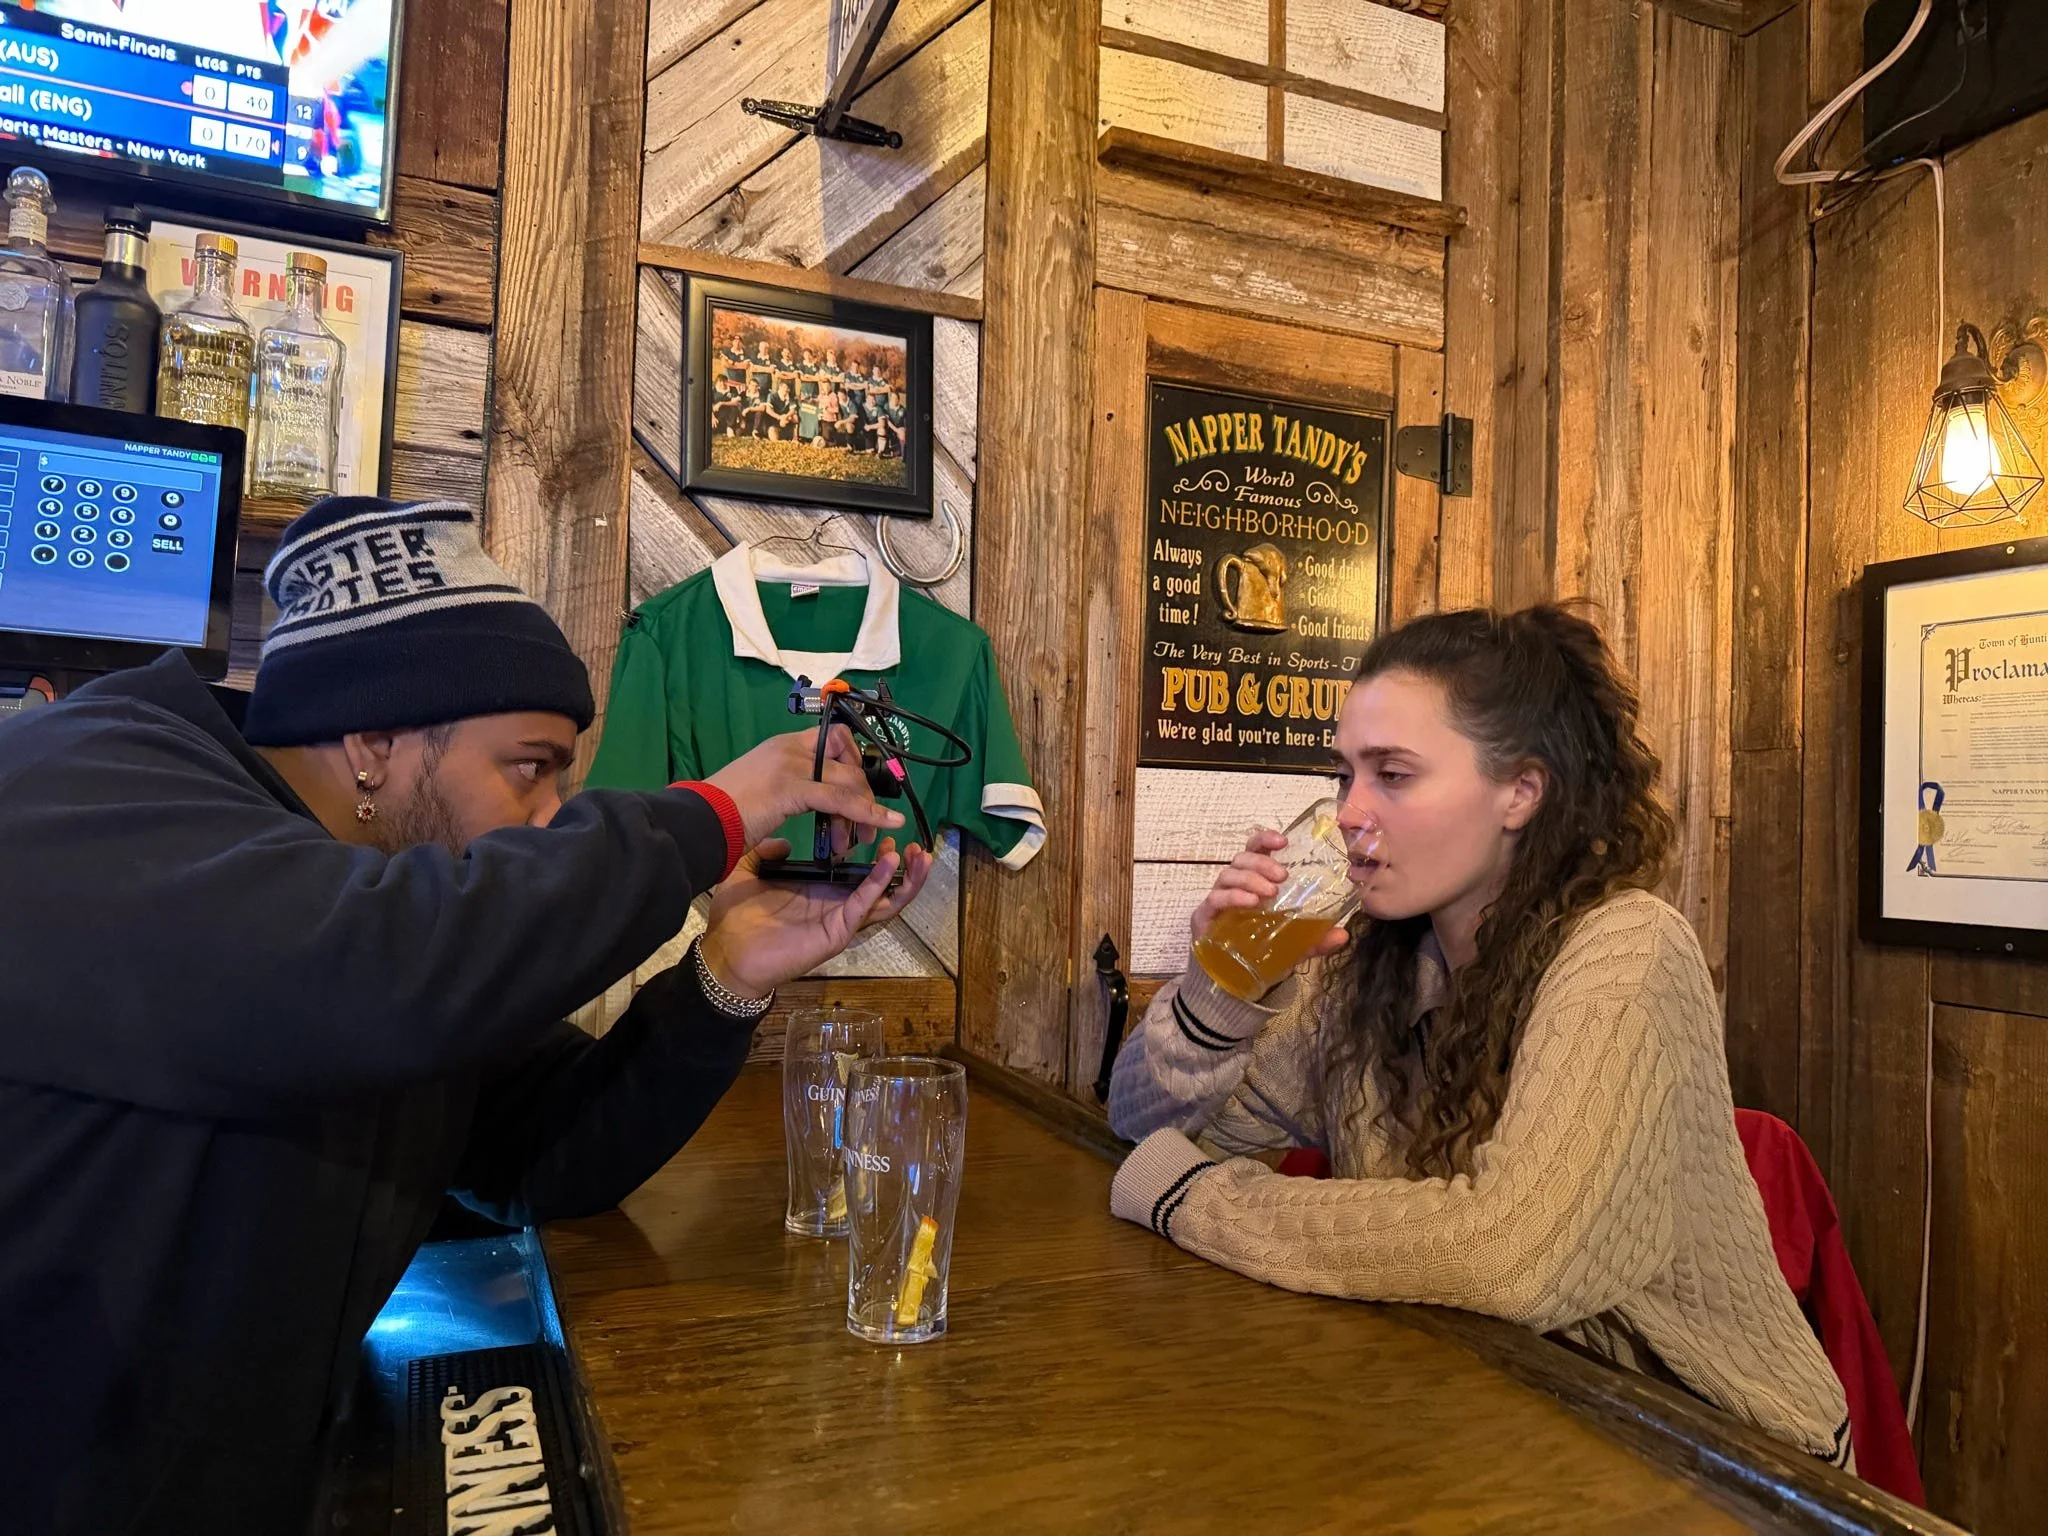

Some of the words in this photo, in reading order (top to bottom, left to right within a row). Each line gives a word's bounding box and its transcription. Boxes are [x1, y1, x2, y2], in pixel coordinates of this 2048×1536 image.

[61, 22, 177, 62] Semi-Finals
[0, 39, 59, 72] (AUS)
[195, 55, 228, 73] LEGS
[236, 63, 262, 80] PTS
[30, 89, 93, 122] (ENG)
[246, 96, 268, 112] 40
[296, 104, 313, 120] 12
[0, 117, 40, 138] arts
[43, 125, 112, 151] Masters
[127, 141, 166, 160] New
[168, 148, 206, 169] York
[124, 443, 161, 456] NAPPER
[1163, 411, 1265, 467] NAPPER
[1272, 414, 1368, 485] TANDY'S
[50, 479, 59, 489] 7
[85, 483, 94, 493] 8
[121, 488, 130, 498] 9
[1243, 466, 1294, 488] World
[1234, 485, 1302, 509] Famous
[45, 501, 55, 511] 4
[82, 506, 92, 515] 5
[118, 510, 127, 519] 6
[79, 529, 89, 538] 2
[115, 533, 125, 543] 3
[152, 538, 184, 551] SELL
[76, 552, 86, 562] 0
[1153, 538, 1202, 569] Always
[1305, 555, 1335, 578] Good
[1153, 575, 1160, 591] a
[1166, 573, 1200, 597] good
[1308, 586, 1338, 607] Good
[1298, 615, 1328, 637] Good
[1333, 617, 1370, 641] friends
[1979, 638, 2005, 649] Town
[2008, 635, 2018, 647] of
[1153, 641, 1185, 658] The
[1192, 644, 1222, 665] Very
[1228, 647, 1262, 665] Best
[1268, 652, 1281, 666] in
[1287, 652, 1329, 672] Sports
[1945, 647, 2048, 692] Proclama
[1161, 667, 1230, 714] PUB
[1236, 672, 1263, 716] &
[1942, 694, 1981, 705] Whereas:
[1157, 719, 1196, 740] We're
[1202, 722, 1233, 745] glad
[1238, 728, 1280, 747] you're
[1285, 726, 1315, 747] here
